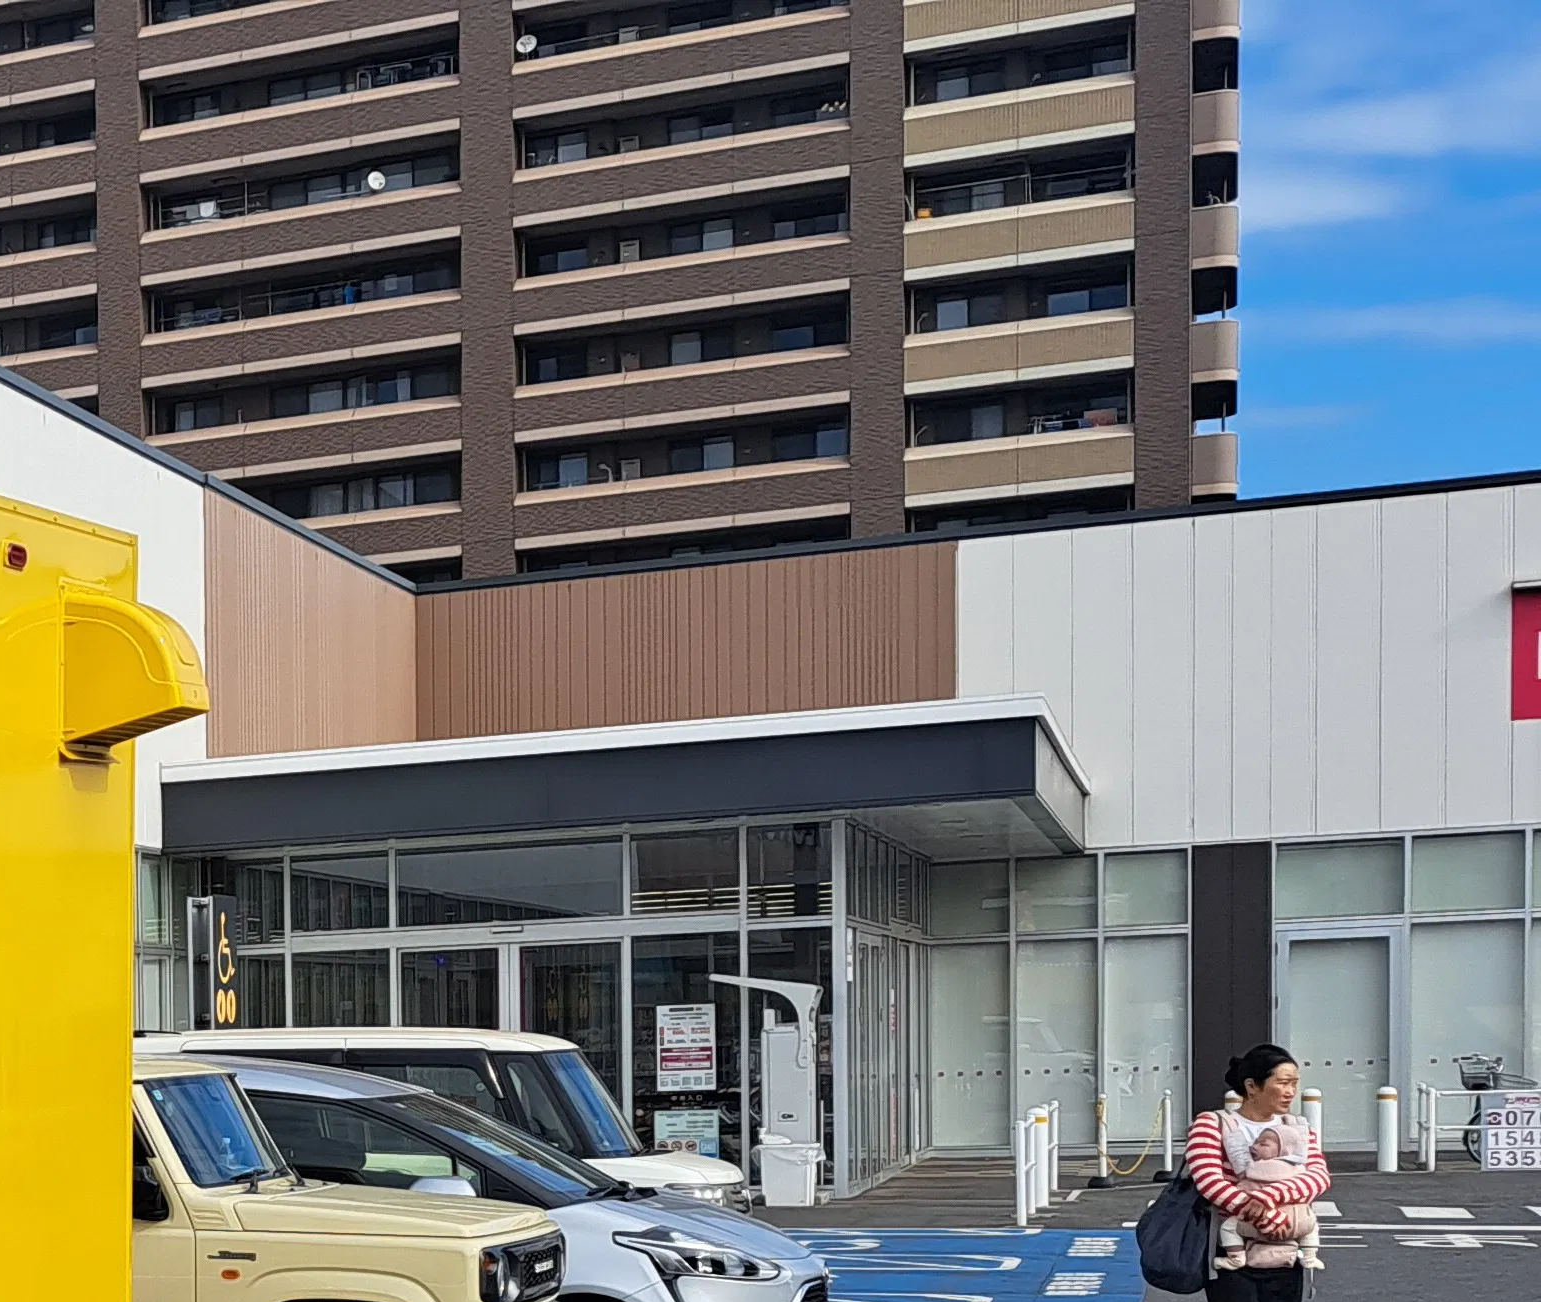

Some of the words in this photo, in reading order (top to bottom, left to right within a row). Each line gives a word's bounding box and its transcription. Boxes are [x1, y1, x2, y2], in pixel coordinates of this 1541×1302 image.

[1506, 1111, 1541, 1126] 07
[1490, 1131, 1541, 1146] 154
[1489, 1151, 1541, 1166] 535
